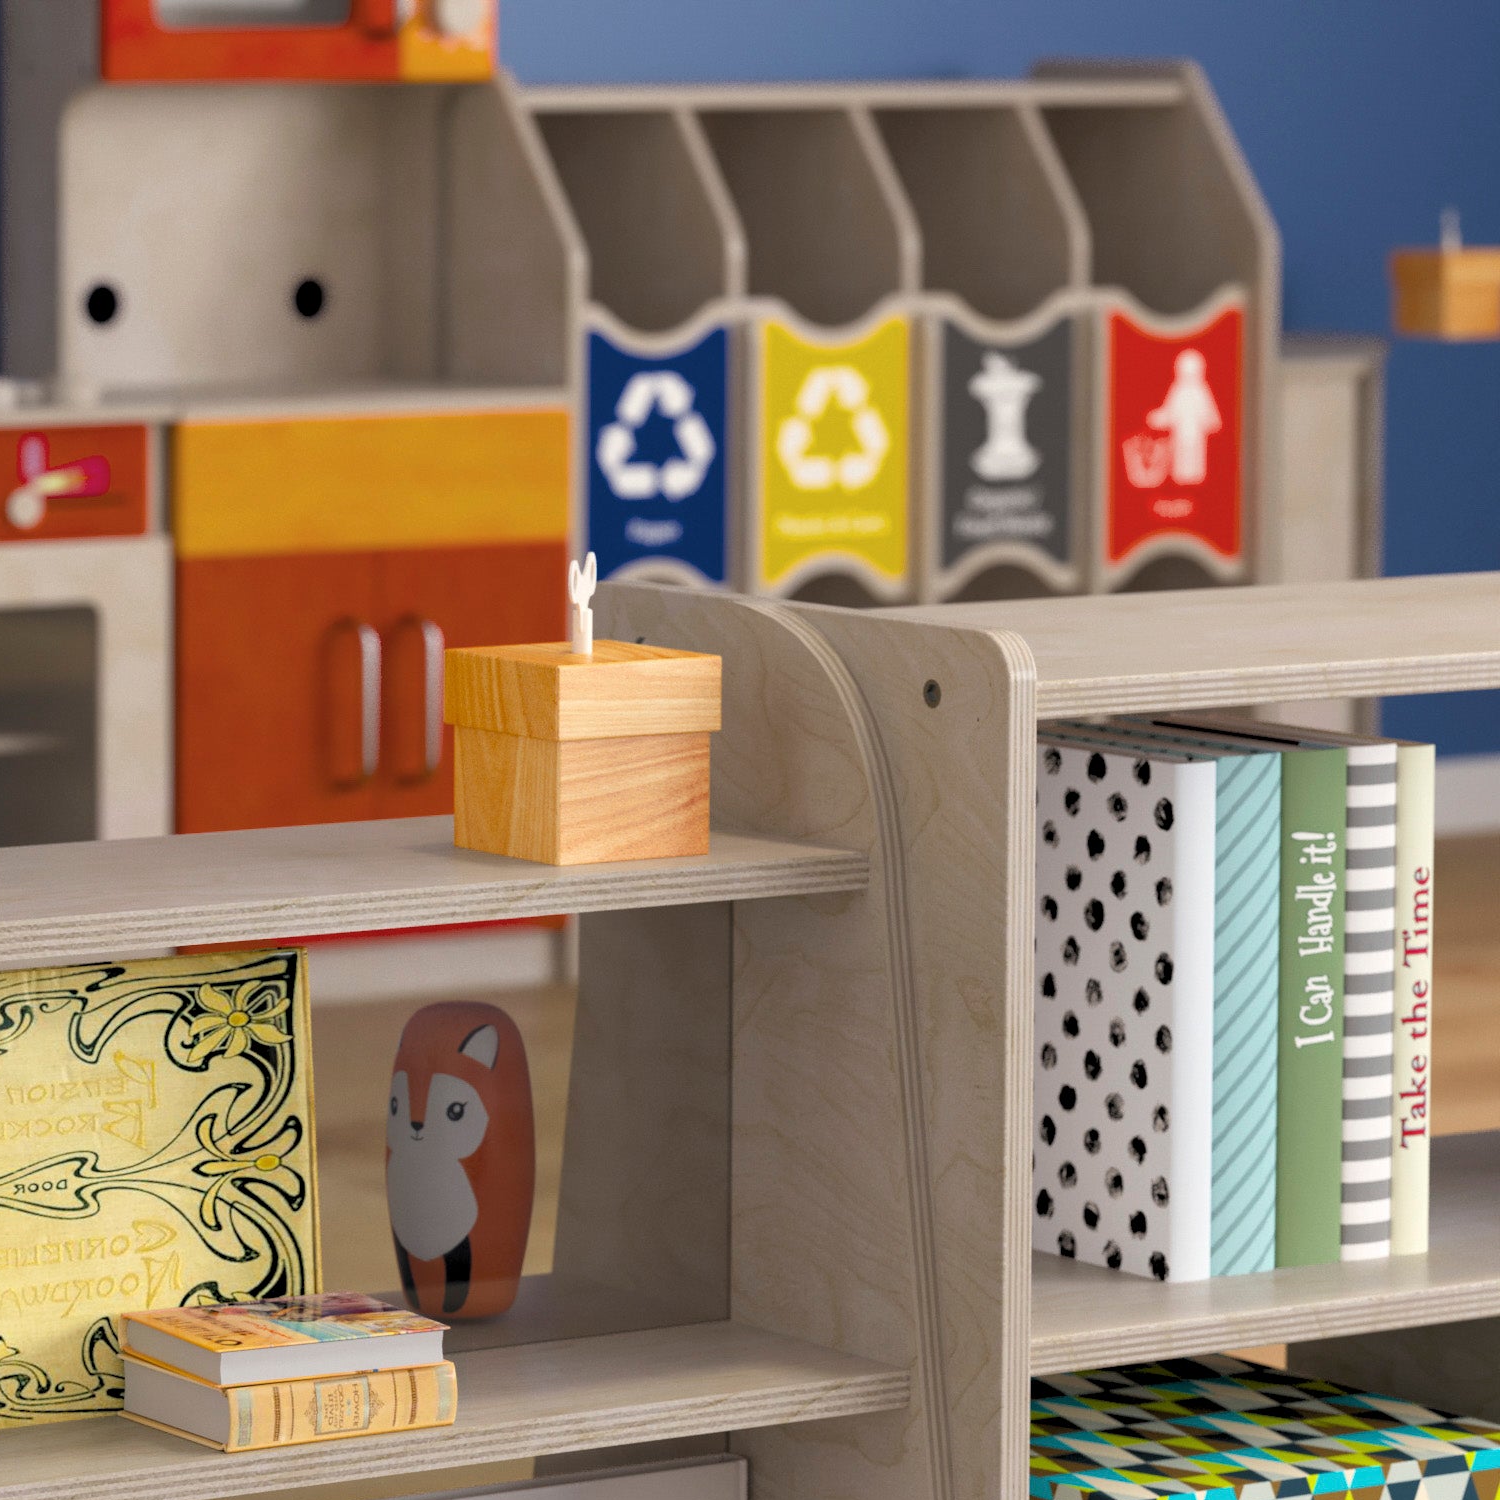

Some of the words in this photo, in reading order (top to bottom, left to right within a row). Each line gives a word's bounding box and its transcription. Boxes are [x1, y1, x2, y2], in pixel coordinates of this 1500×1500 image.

[1291, 831, 1337, 865] it!
[1295, 869, 1337, 957] Handle
[1402, 865, 1431, 969] Time
[1299, 973, 1335, 1029] Can
[1401, 979, 1429, 1041] the
[1295, 1030, 1335, 1048] I
[1400, 1051, 1428, 1150] Take
